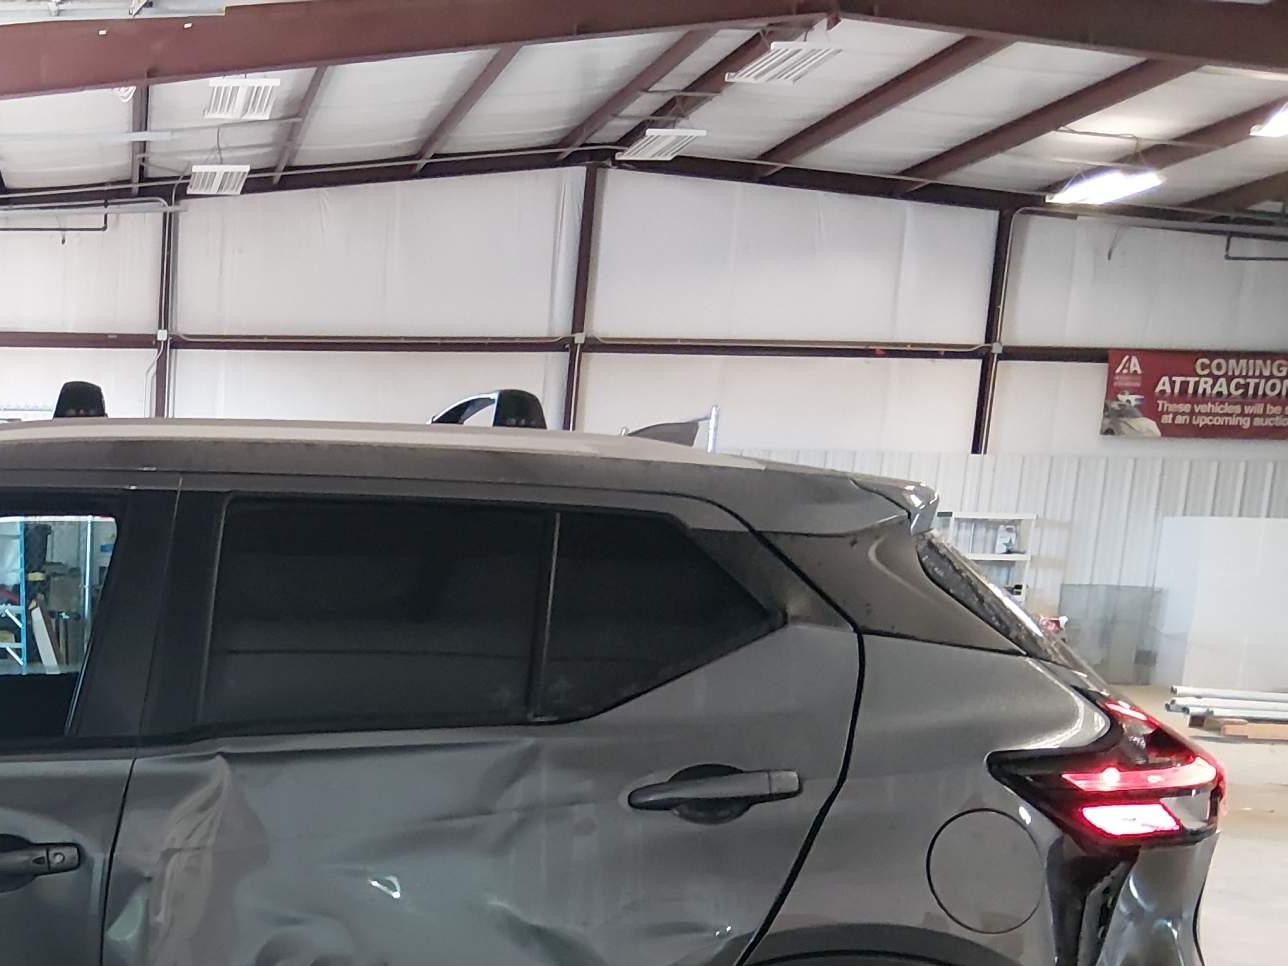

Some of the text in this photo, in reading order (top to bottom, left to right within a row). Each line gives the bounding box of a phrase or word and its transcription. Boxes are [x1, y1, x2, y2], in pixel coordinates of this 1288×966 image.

[1194, 358, 1288, 377] COMING
[1157, 400, 1191, 413] These
[1194, 401, 1241, 414] vehicles
[1244, 403, 1264, 415] will
[1266, 403, 1282, 415] be
[1160, 414, 1173, 424] at
[1174, 416, 1190, 425] an
[1192, 415, 1250, 429] upcoming
